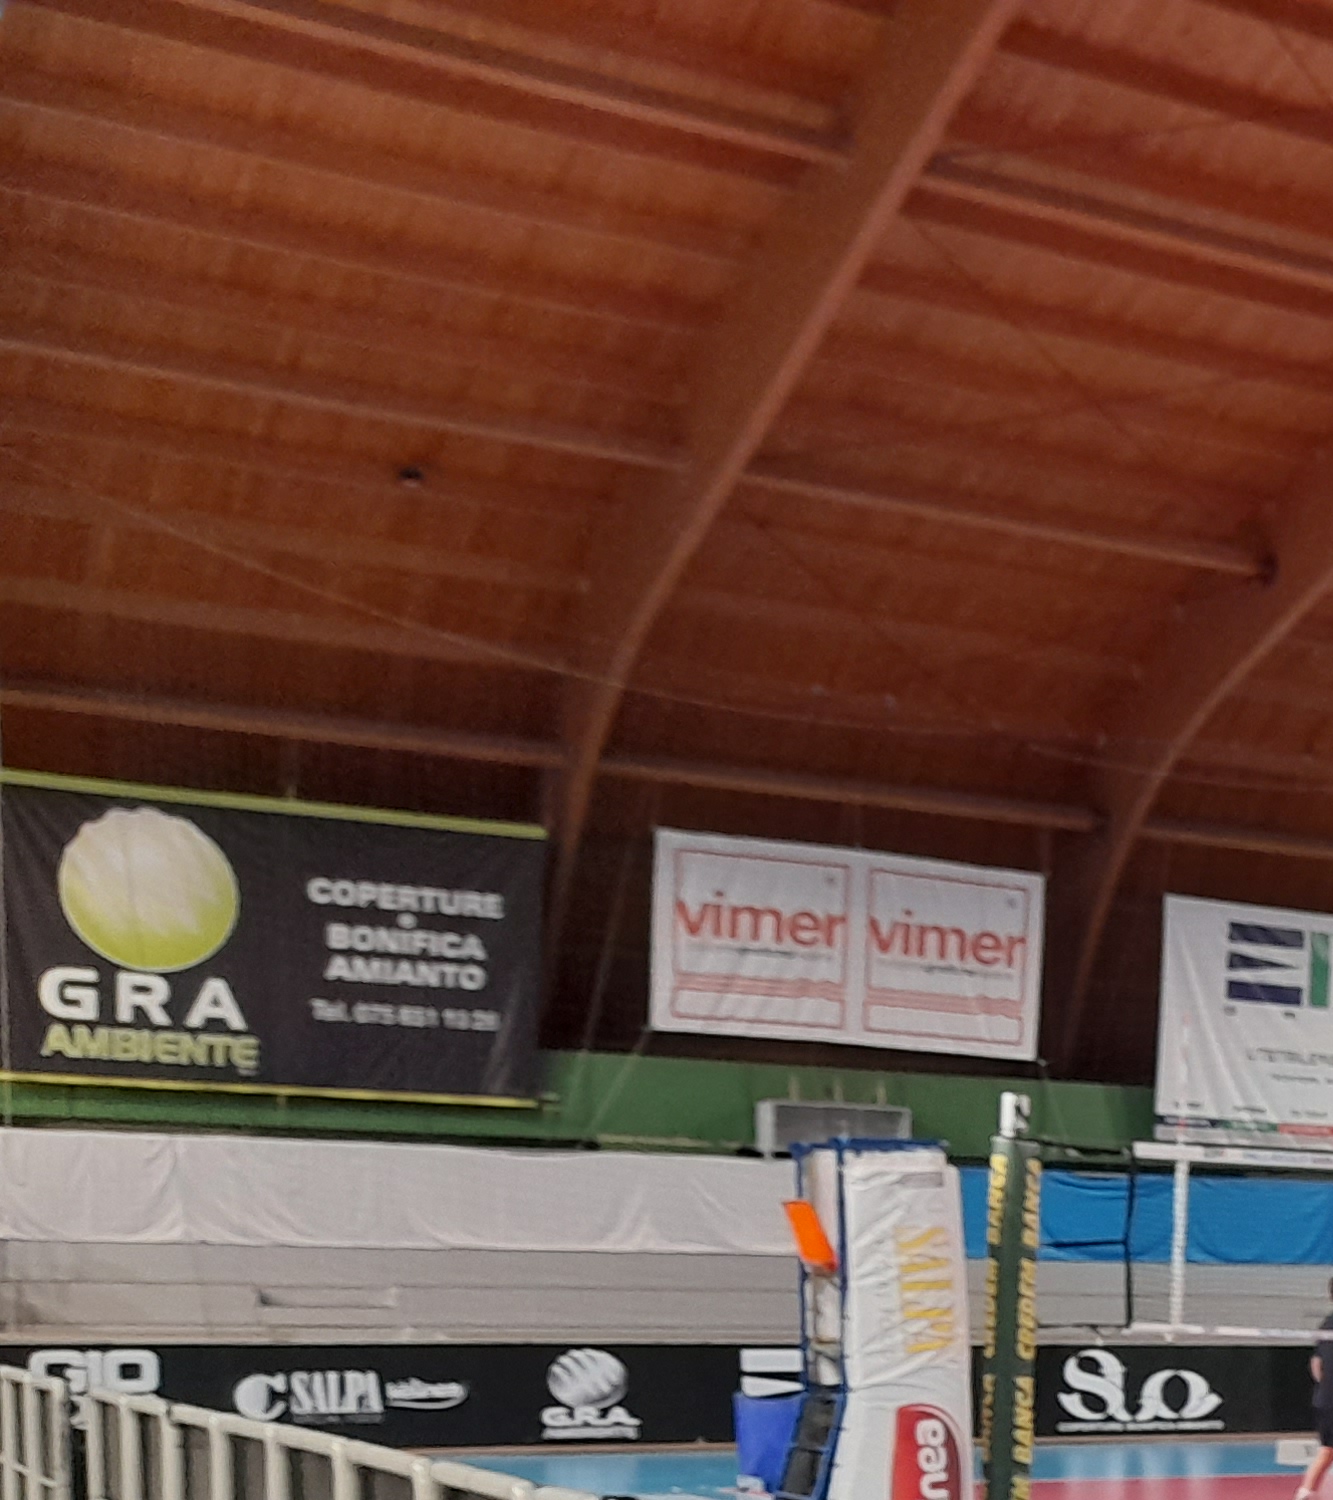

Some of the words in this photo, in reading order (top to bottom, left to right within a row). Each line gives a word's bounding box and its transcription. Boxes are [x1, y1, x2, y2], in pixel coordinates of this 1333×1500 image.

[306, 876, 505, 920] COPERTURE
[674, 889, 849, 948] vimer
[325, 922, 488, 961] BONIFICA
[868, 908, 1027, 968] vimer
[37, 965, 249, 1032] GRA
[323, 955, 487, 991] AMIANTO
[39, 1022, 261, 1071] AMBIENTE
[1021, 1157, 1043, 1248] BANCA
[540, 1405, 643, 1427] GRA
[1012, 1375, 1036, 1465] BANCA
